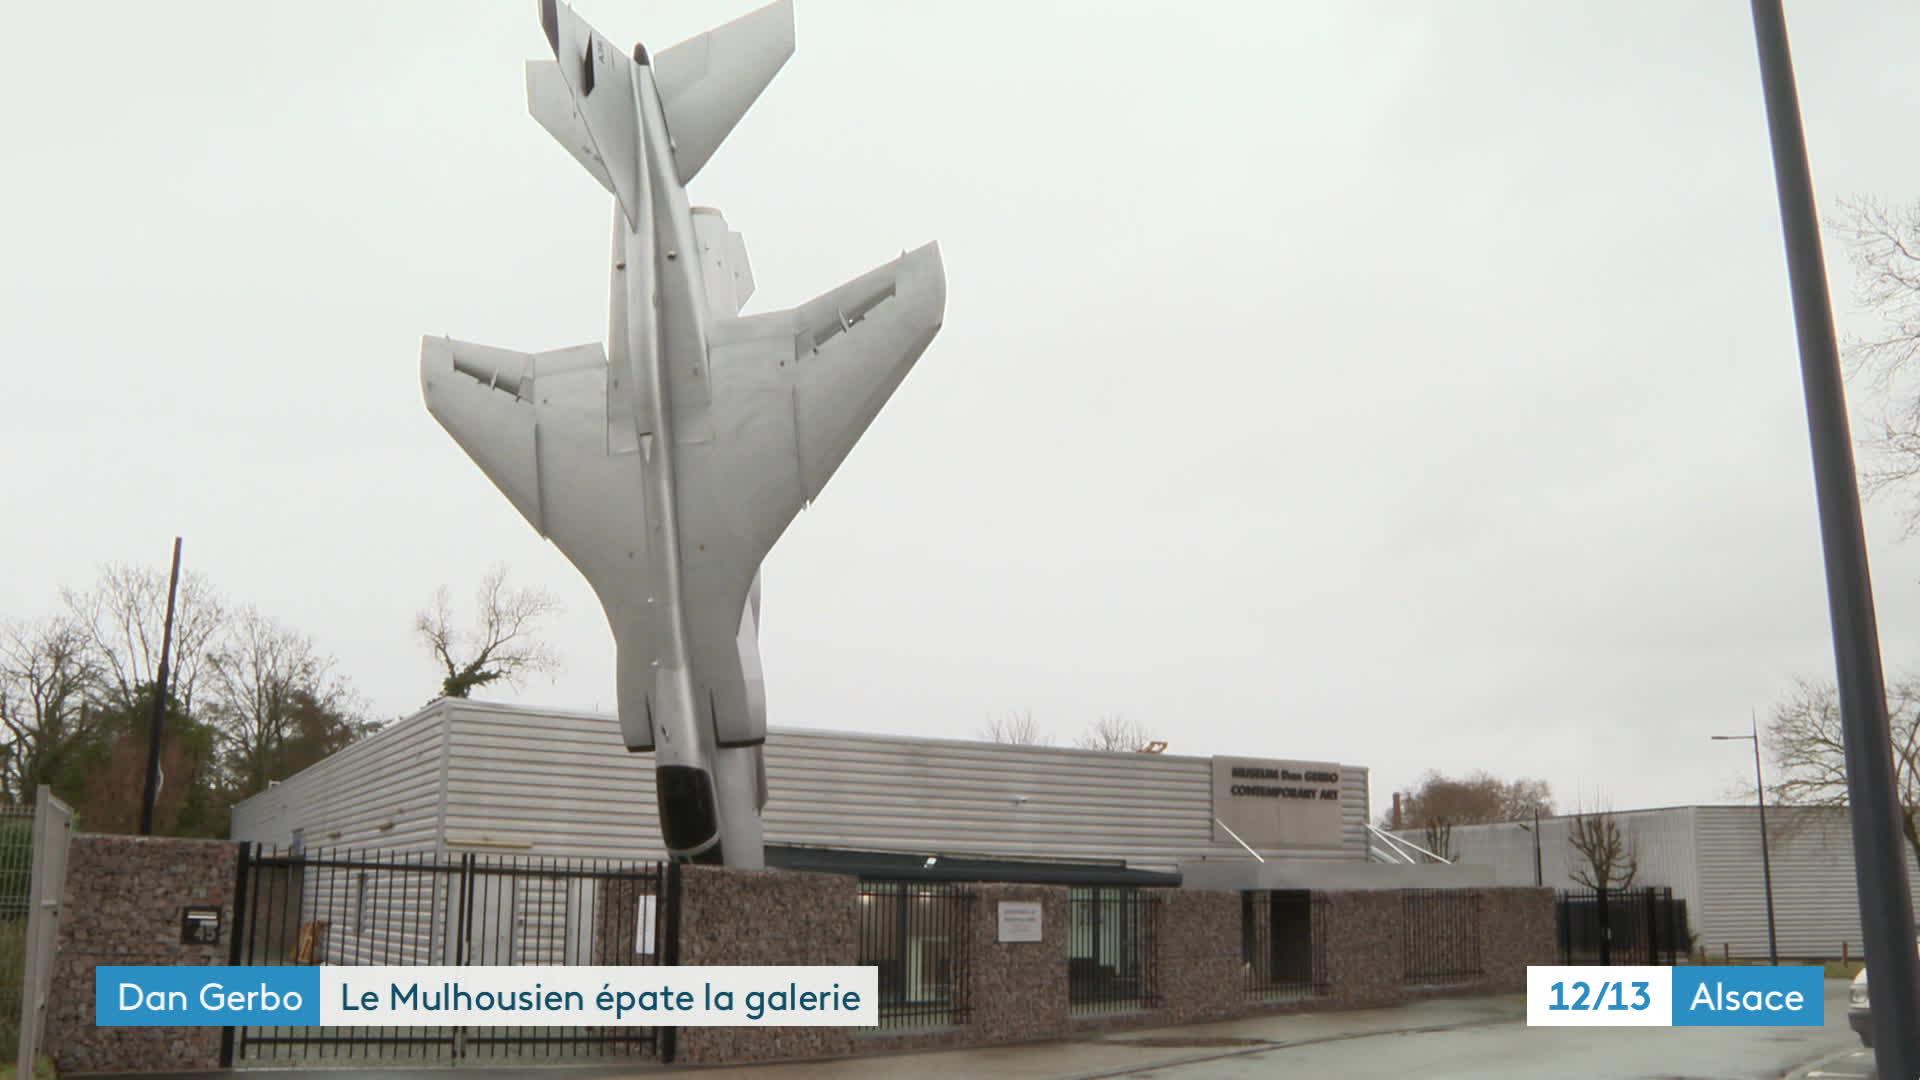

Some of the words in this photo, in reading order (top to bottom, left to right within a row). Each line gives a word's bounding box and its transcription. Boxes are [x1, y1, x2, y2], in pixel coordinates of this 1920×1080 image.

[1231, 767, 1278, 779] MUSEUM
[1281, 769, 1302, 781] Dan
[1230, 784, 1317, 799] CONTEMPORARY
[1319, 789, 1338, 801] ART
